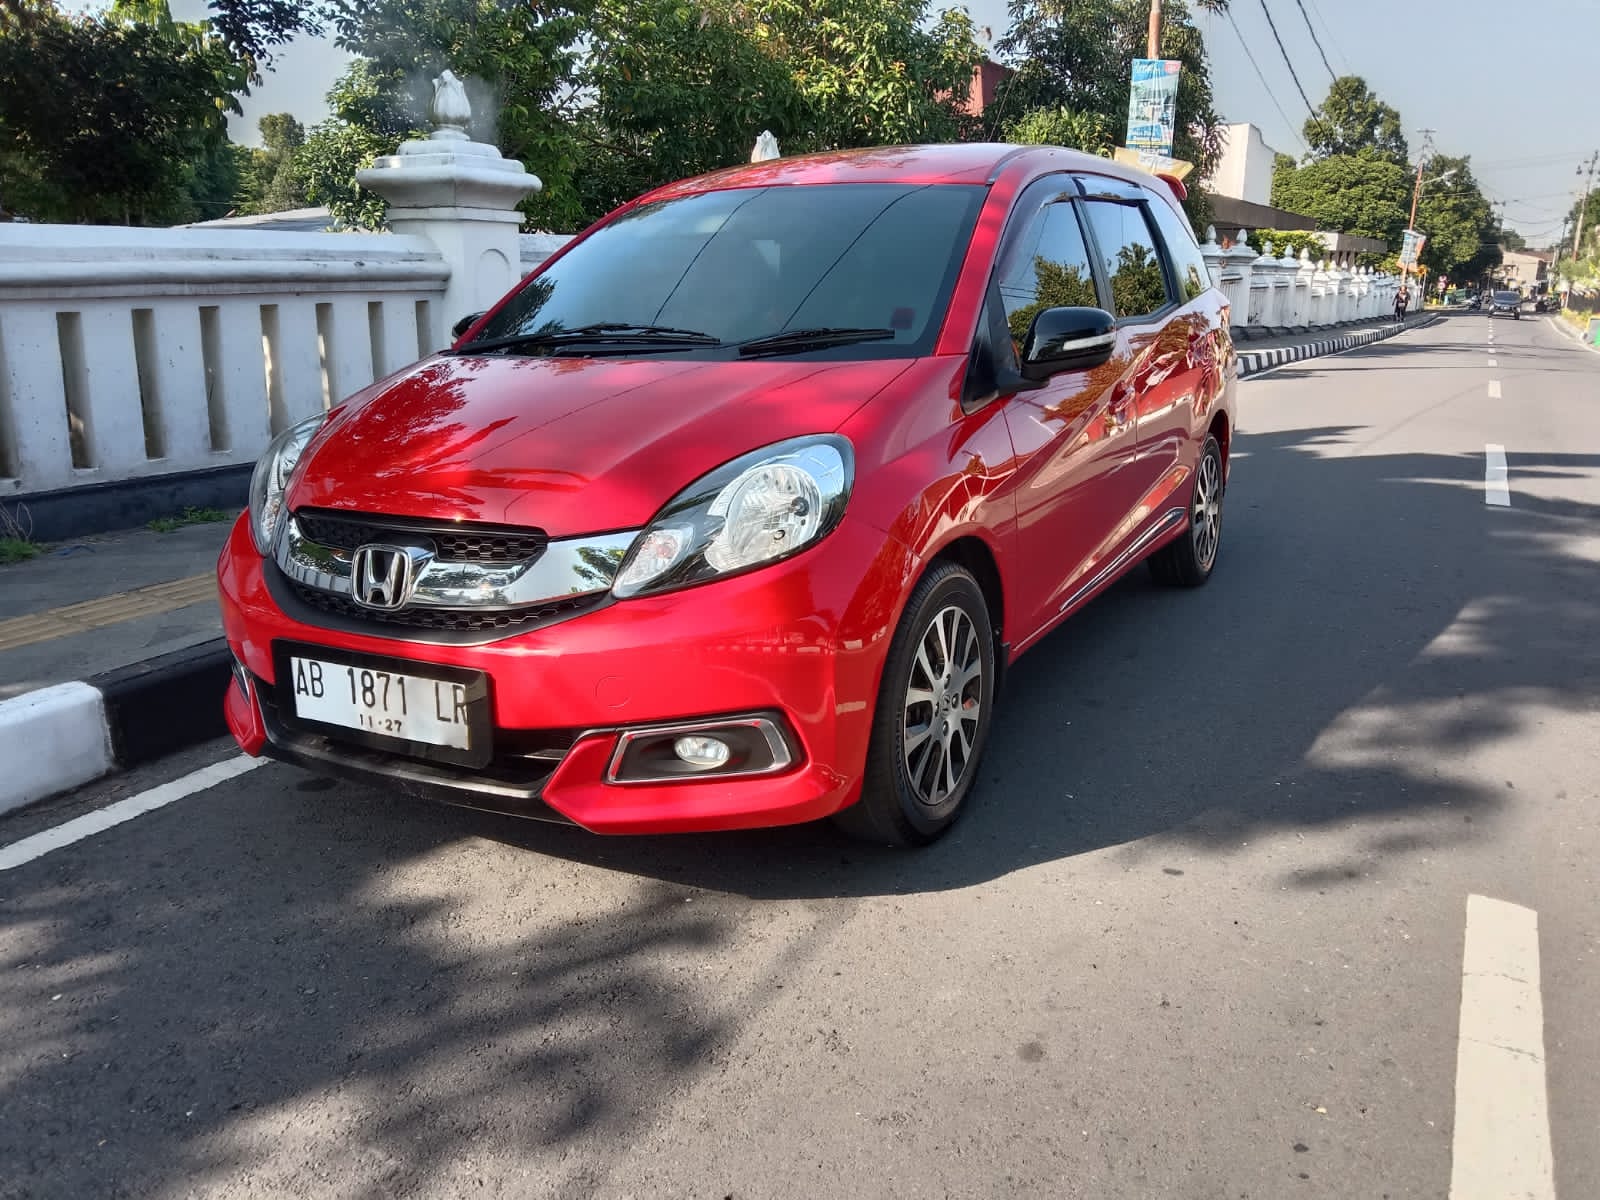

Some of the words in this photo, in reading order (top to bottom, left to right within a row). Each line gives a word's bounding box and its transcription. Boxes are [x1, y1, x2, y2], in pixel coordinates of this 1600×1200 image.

[296, 659, 325, 698] AB
[347, 667, 407, 716] 1871
[434, 682, 468, 725] LR
